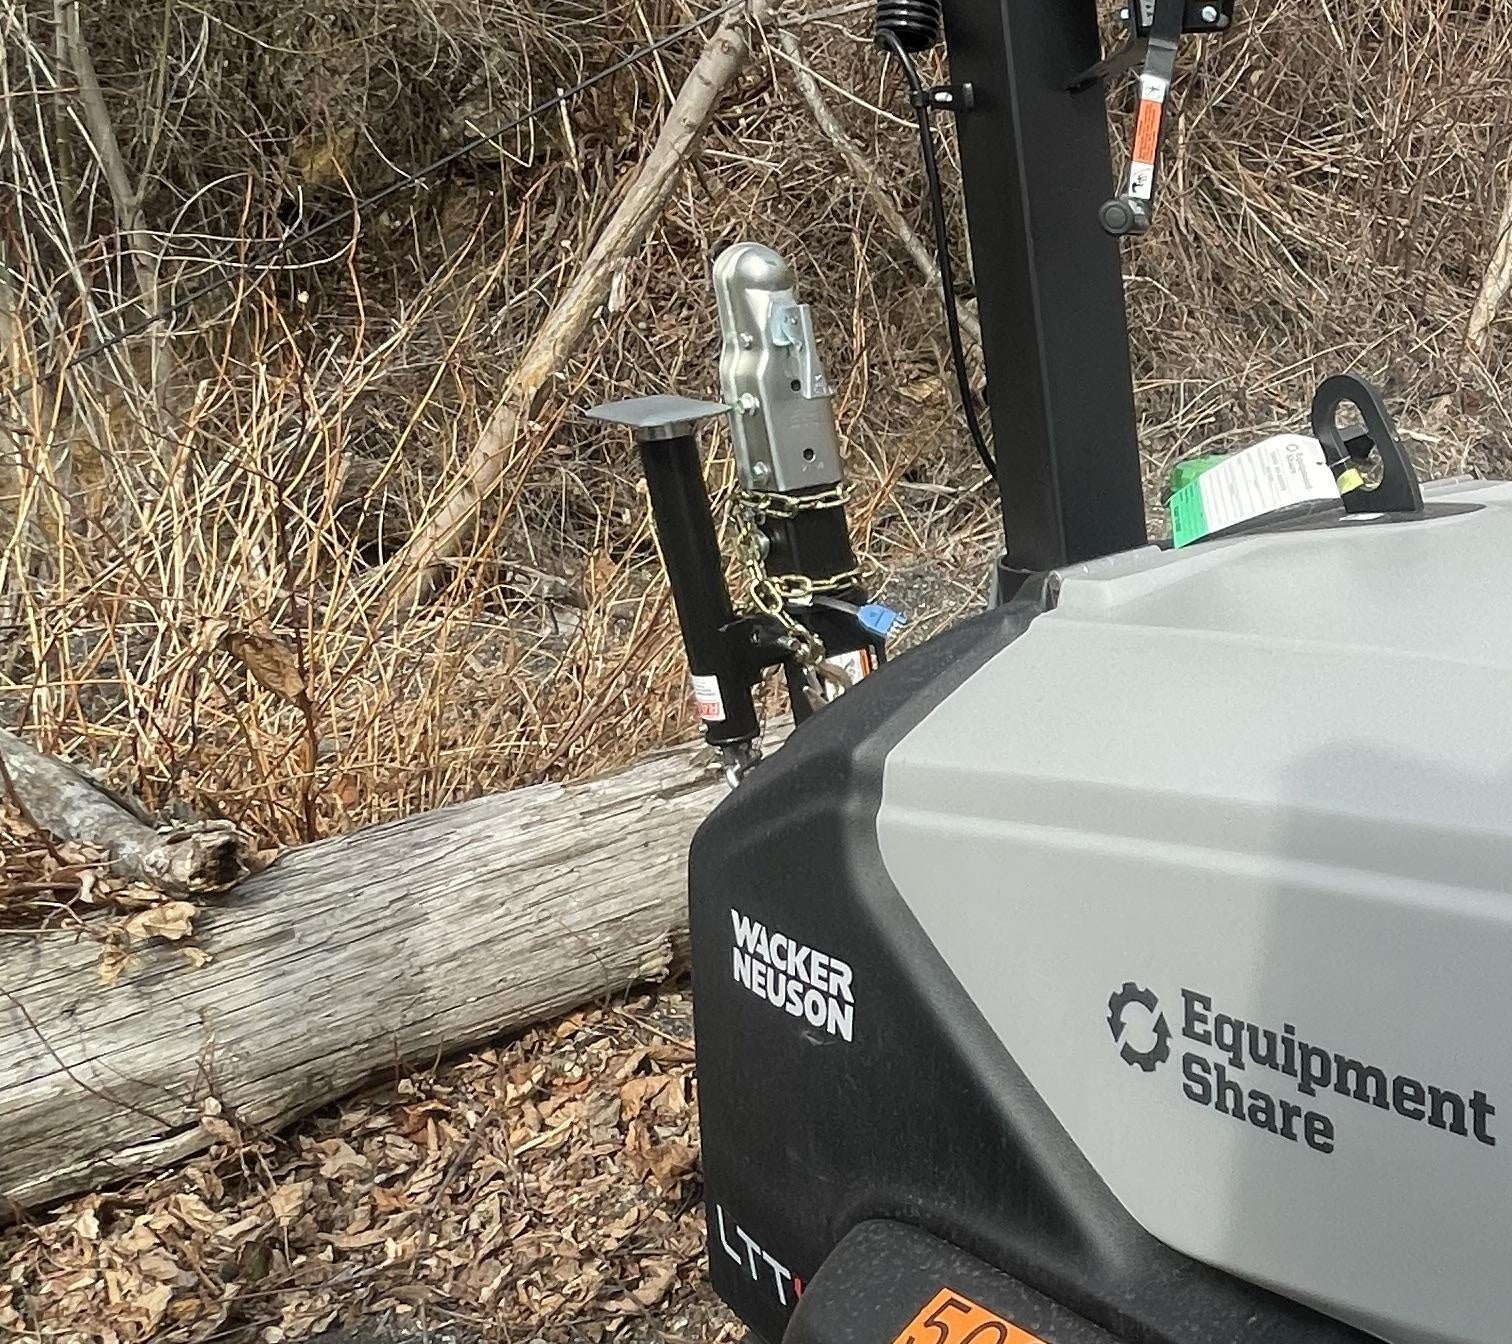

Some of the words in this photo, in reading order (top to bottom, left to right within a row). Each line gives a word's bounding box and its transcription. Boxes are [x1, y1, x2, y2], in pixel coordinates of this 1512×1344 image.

[730, 908, 855, 1004] WACKER
[732, 946, 854, 1043] NEUSON
[1180, 988, 1497, 1147] Equipment
[1181, 1051, 1335, 1155] Share
